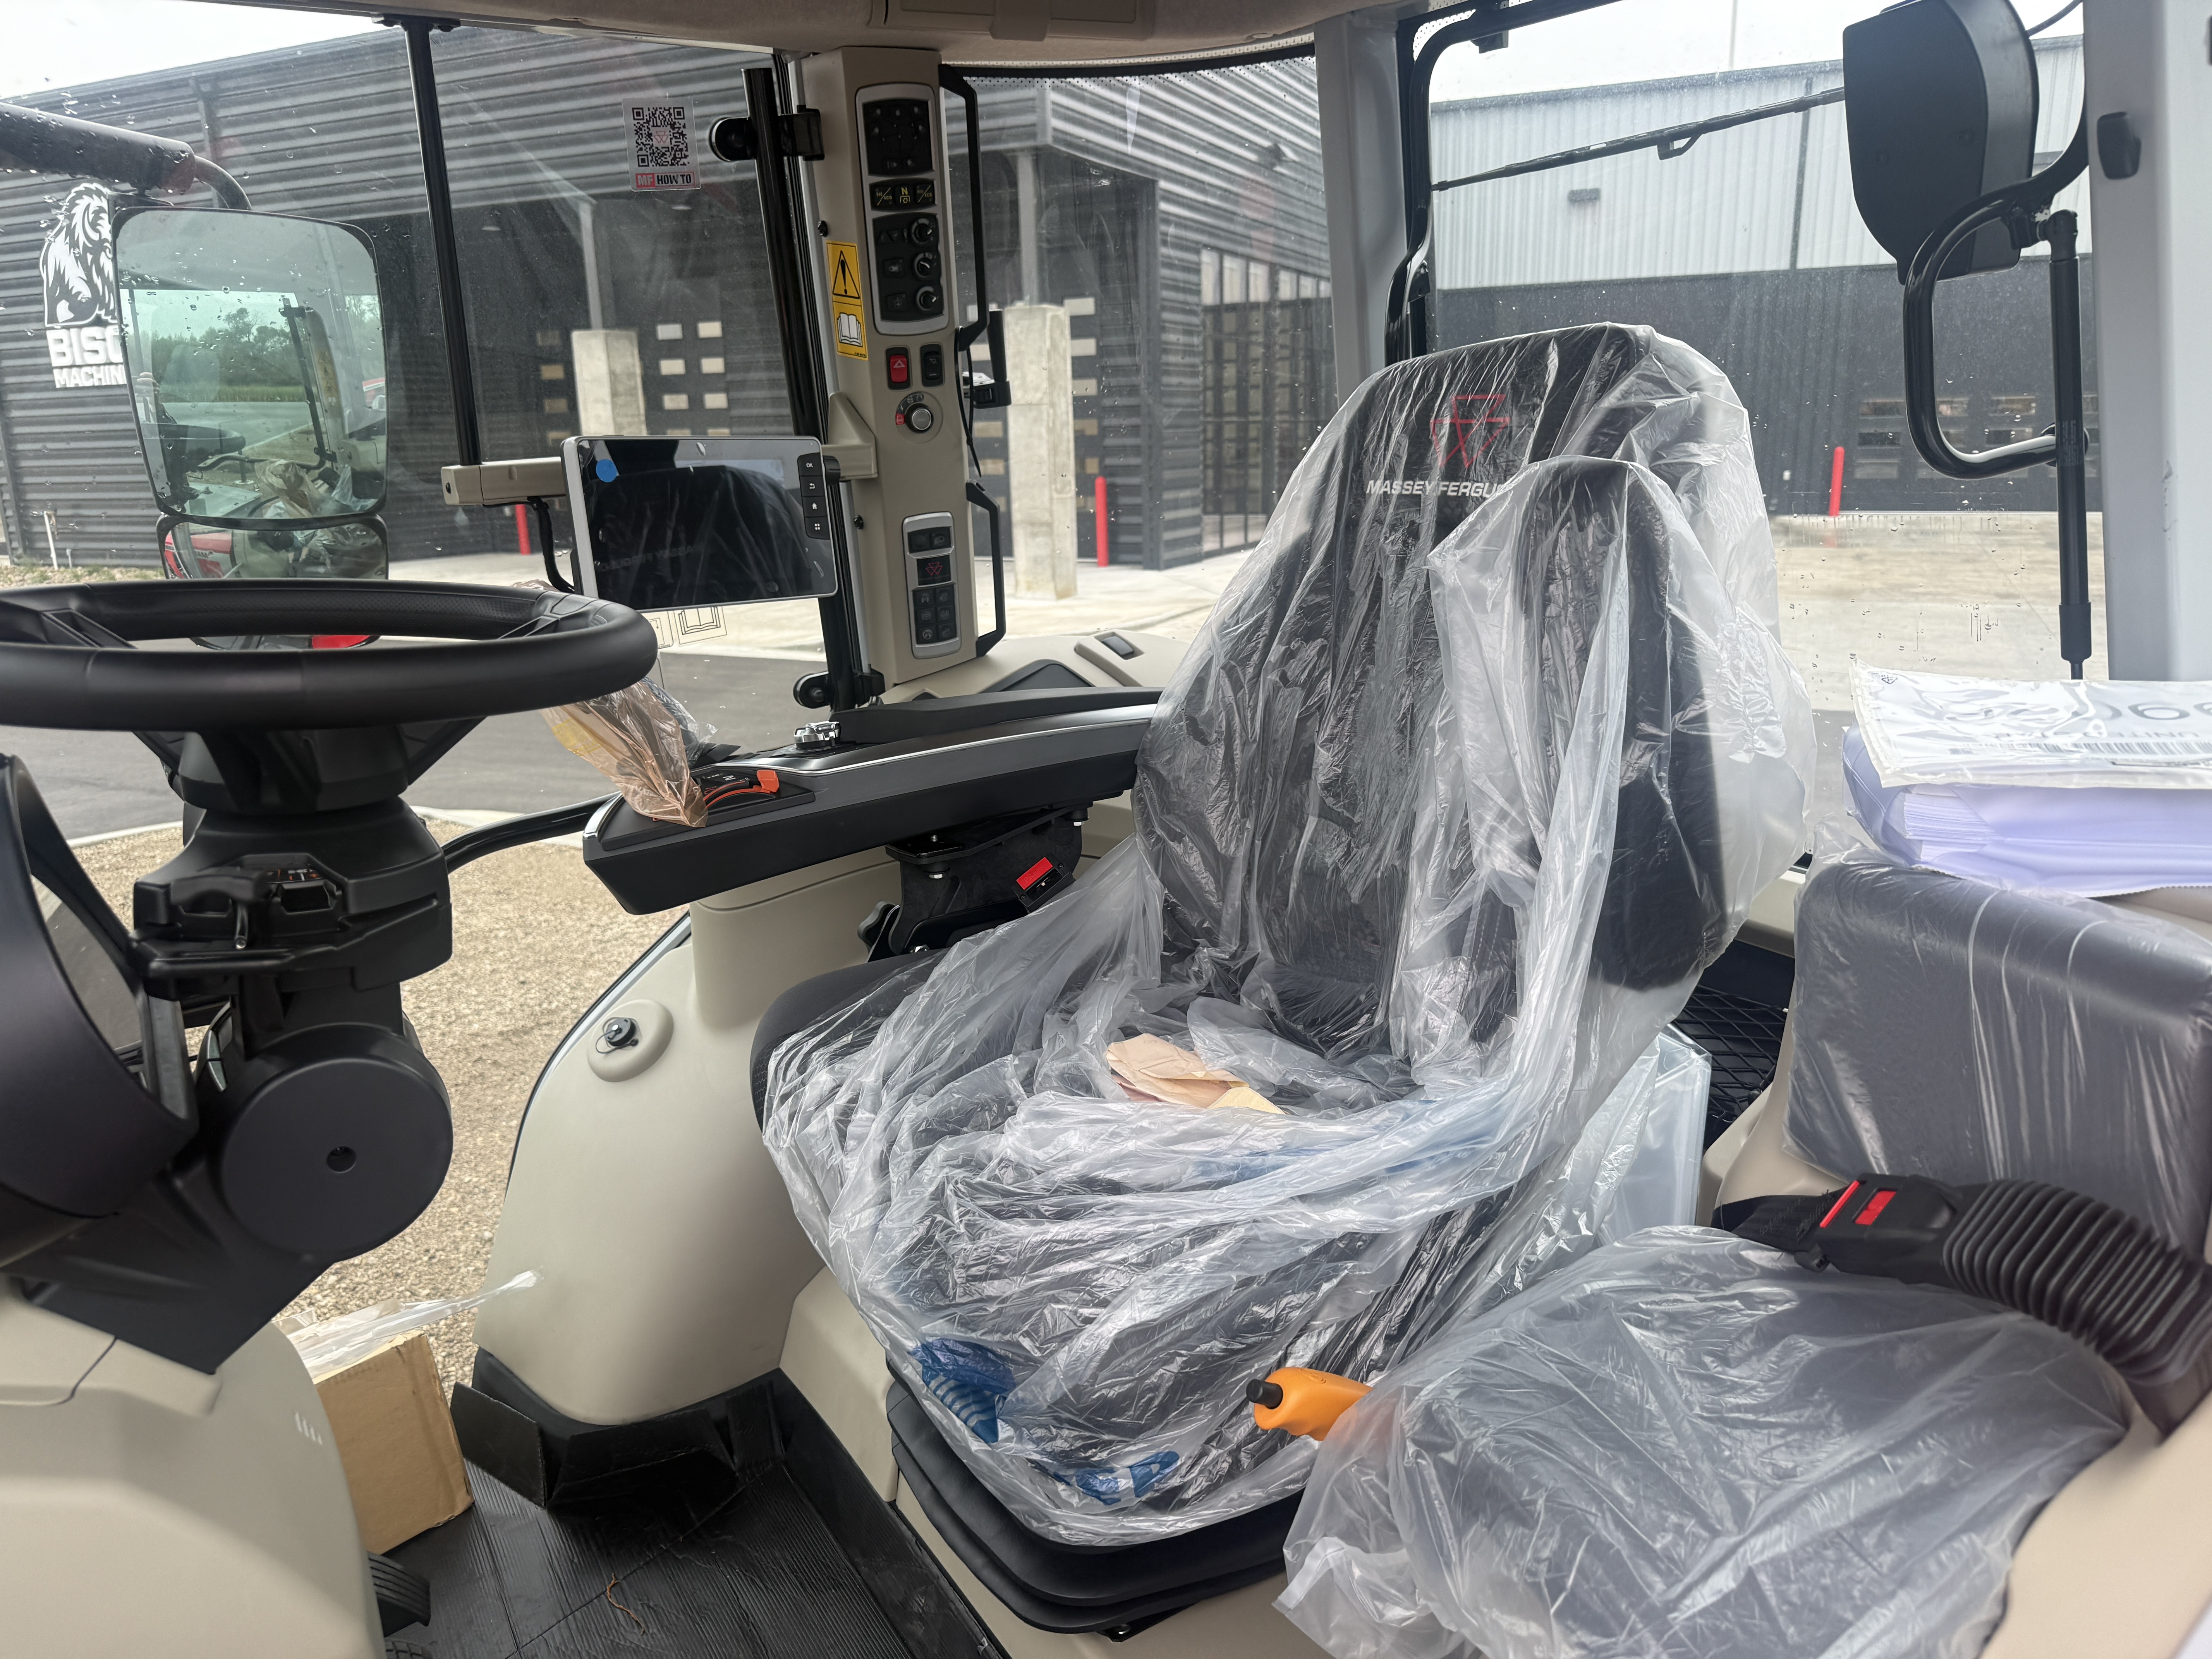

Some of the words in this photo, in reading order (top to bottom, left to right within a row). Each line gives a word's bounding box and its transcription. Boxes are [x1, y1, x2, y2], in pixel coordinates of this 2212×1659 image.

[637, 175, 653, 185] MF
[657, 174, 678, 185] HOW
[680, 174, 692, 184] TO
[901, 187, 908, 195] N
[1366, 479, 1432, 495] MASSEY
